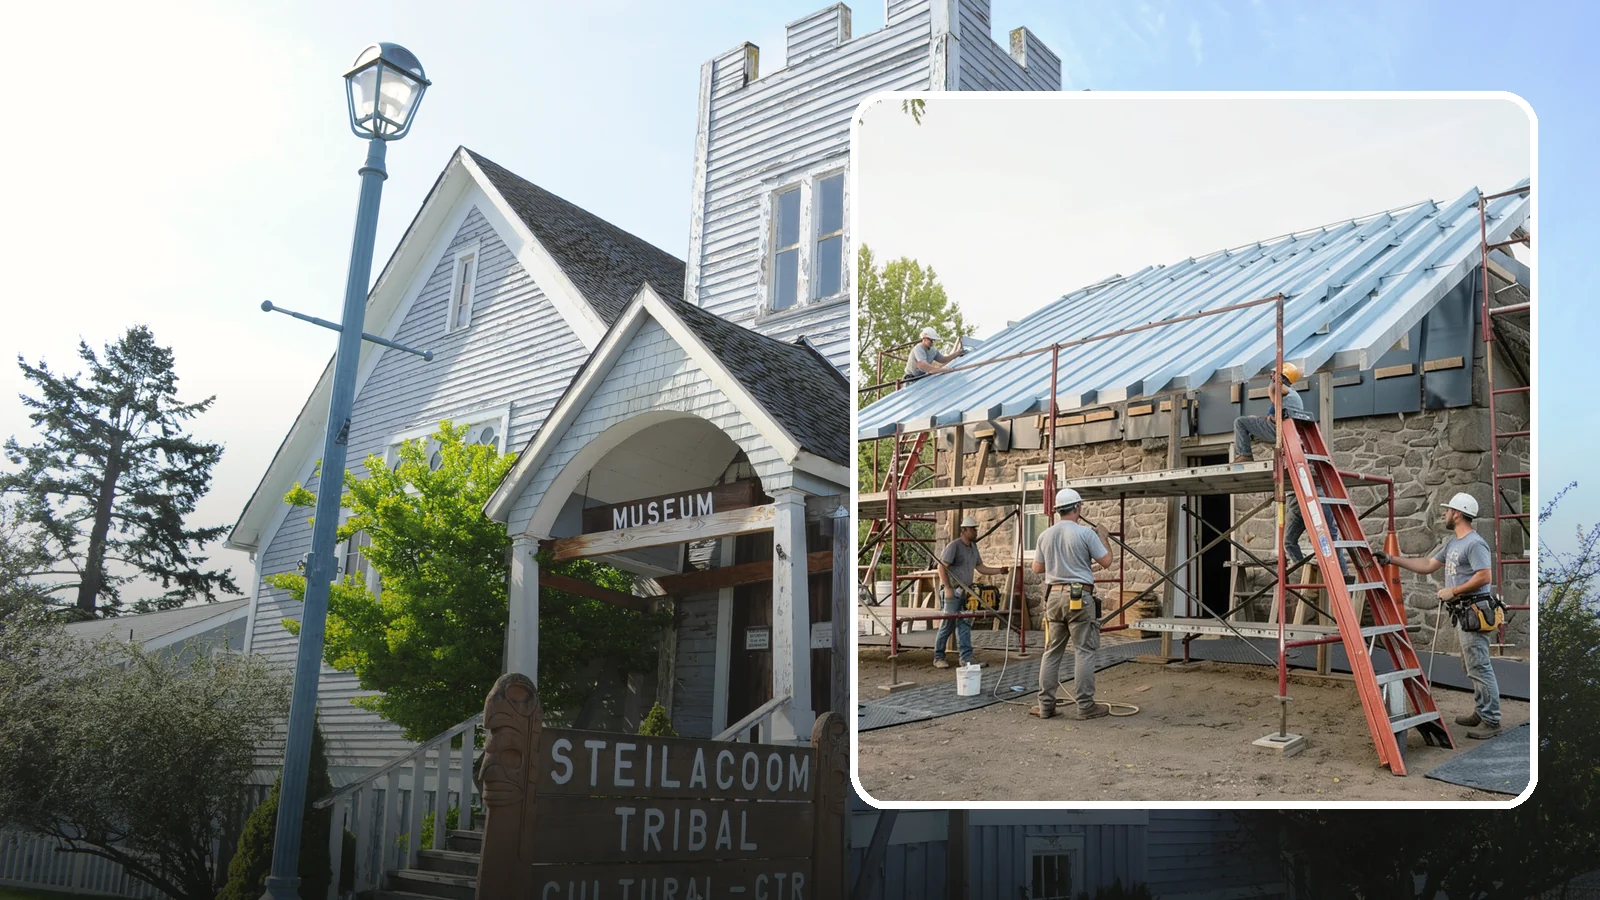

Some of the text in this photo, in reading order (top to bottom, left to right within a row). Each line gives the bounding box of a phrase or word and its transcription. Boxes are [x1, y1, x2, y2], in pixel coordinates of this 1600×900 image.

[612, 492, 714, 530] MUSEUM
[550, 738, 809, 792] STEILACOOM
[614, 807, 758, 852] TRIBAL
